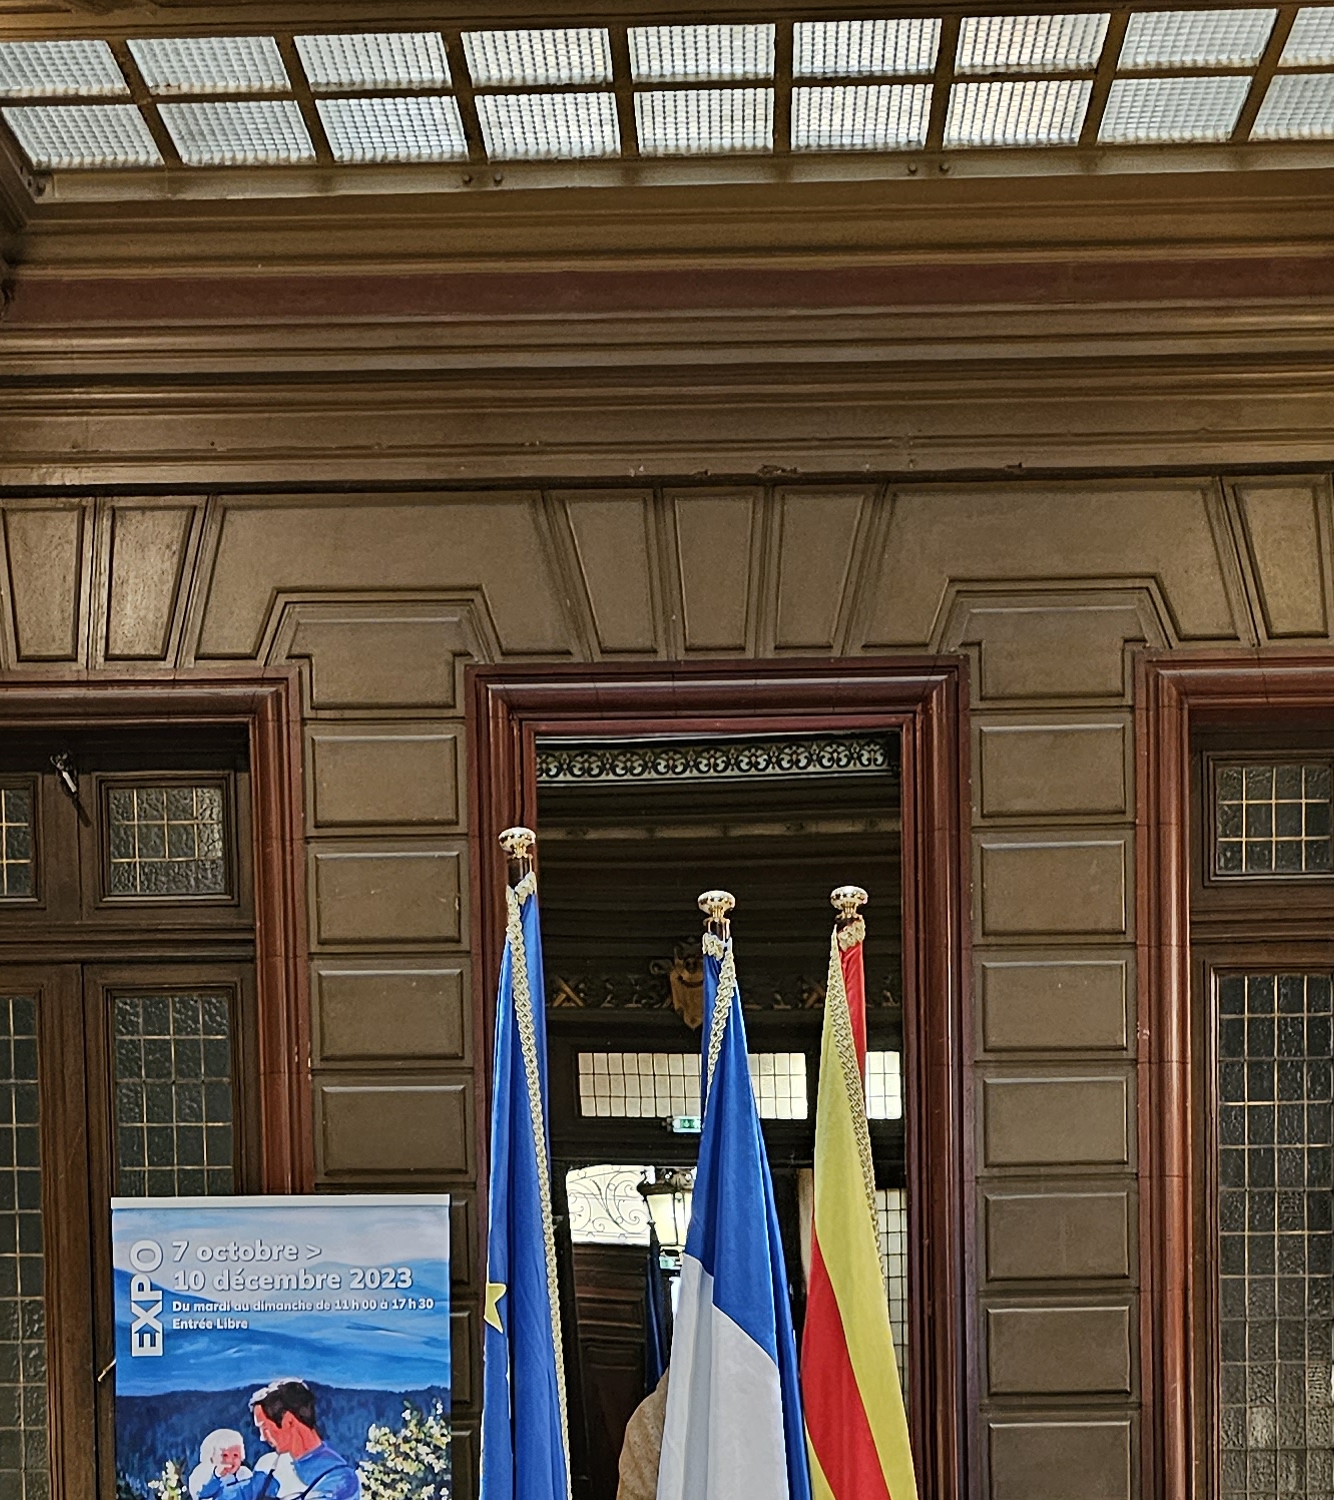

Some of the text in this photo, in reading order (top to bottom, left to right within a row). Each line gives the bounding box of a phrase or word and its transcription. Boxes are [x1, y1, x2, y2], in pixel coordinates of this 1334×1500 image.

[172, 1241, 190, 1263] 7
[196, 1240, 299, 1263] octobre
[174, 1267, 414, 1292] 10 décembre 2023
[130, 1239, 163, 1357] EXPO
[172, 1301, 191, 1313] Du
[193, 1301, 231, 1313] mardi
[234, 1303, 250, 1312] au
[253, 1300, 312, 1312] dimanche
[316, 1300, 331, 1311] de
[172, 1318, 248, 1330] Entrée Libre
